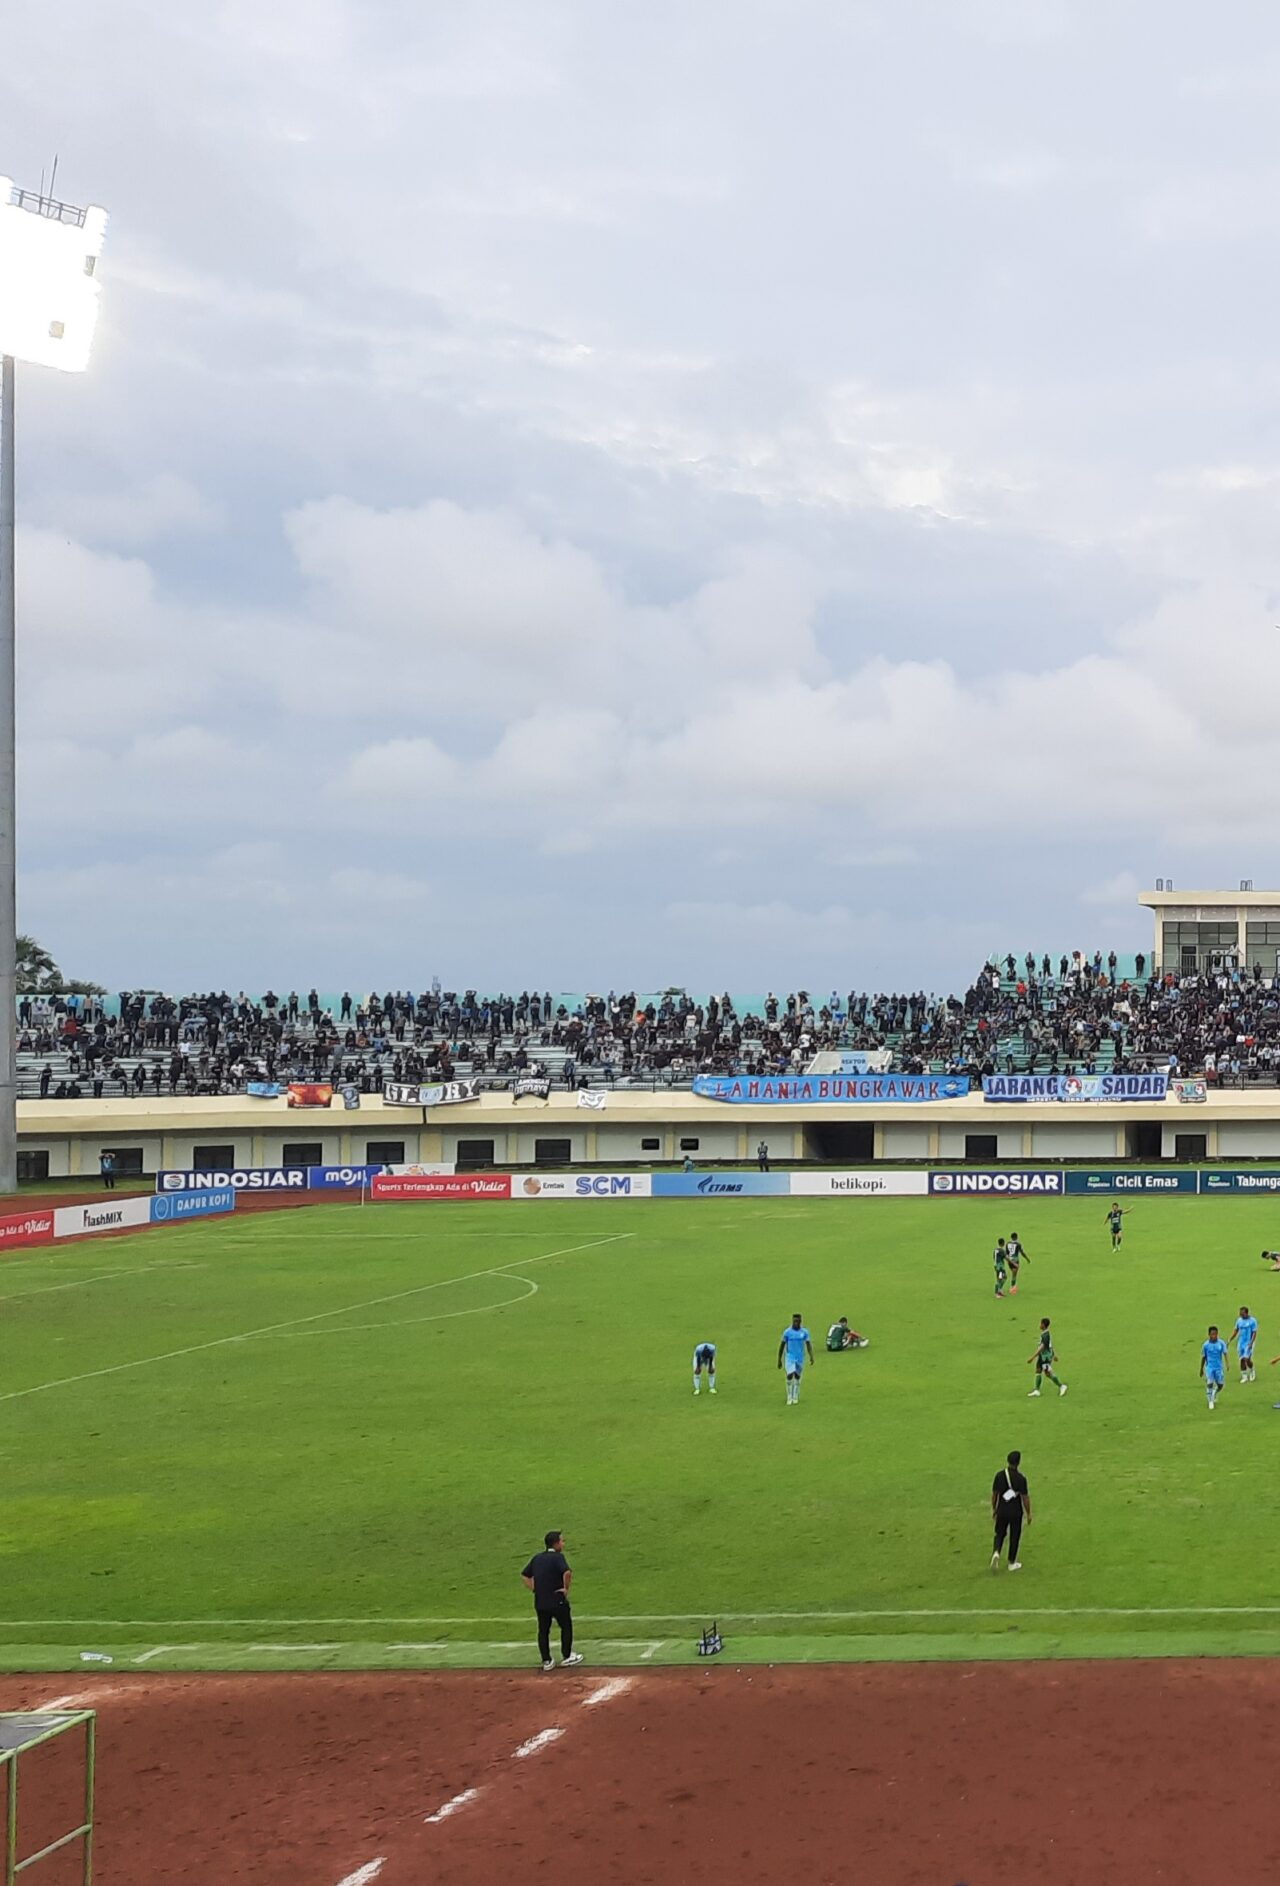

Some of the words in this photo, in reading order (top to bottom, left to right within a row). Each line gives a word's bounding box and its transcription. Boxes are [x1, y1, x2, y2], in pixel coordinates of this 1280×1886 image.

[819, 1080, 939, 1098] BUNGKAWAK
[986, 1076, 1058, 1096] JARANG
[1102, 1076, 1165, 1096] SADAR
[188, 1171, 303, 1189] INDOSIAR
[471, 1180, 506, 1193] Vidio
[576, 1176, 631, 1195] SCM
[831, 1177, 887, 1192] belikopi.
[955, 1174, 1059, 1191] INDOSIAR
[1115, 1175, 1142, 1188] Cicil
[1145, 1175, 1178, 1188] Emas
[177, 1196, 207, 1211] DAPUR
[209, 1193, 231, 1208] KOPI
